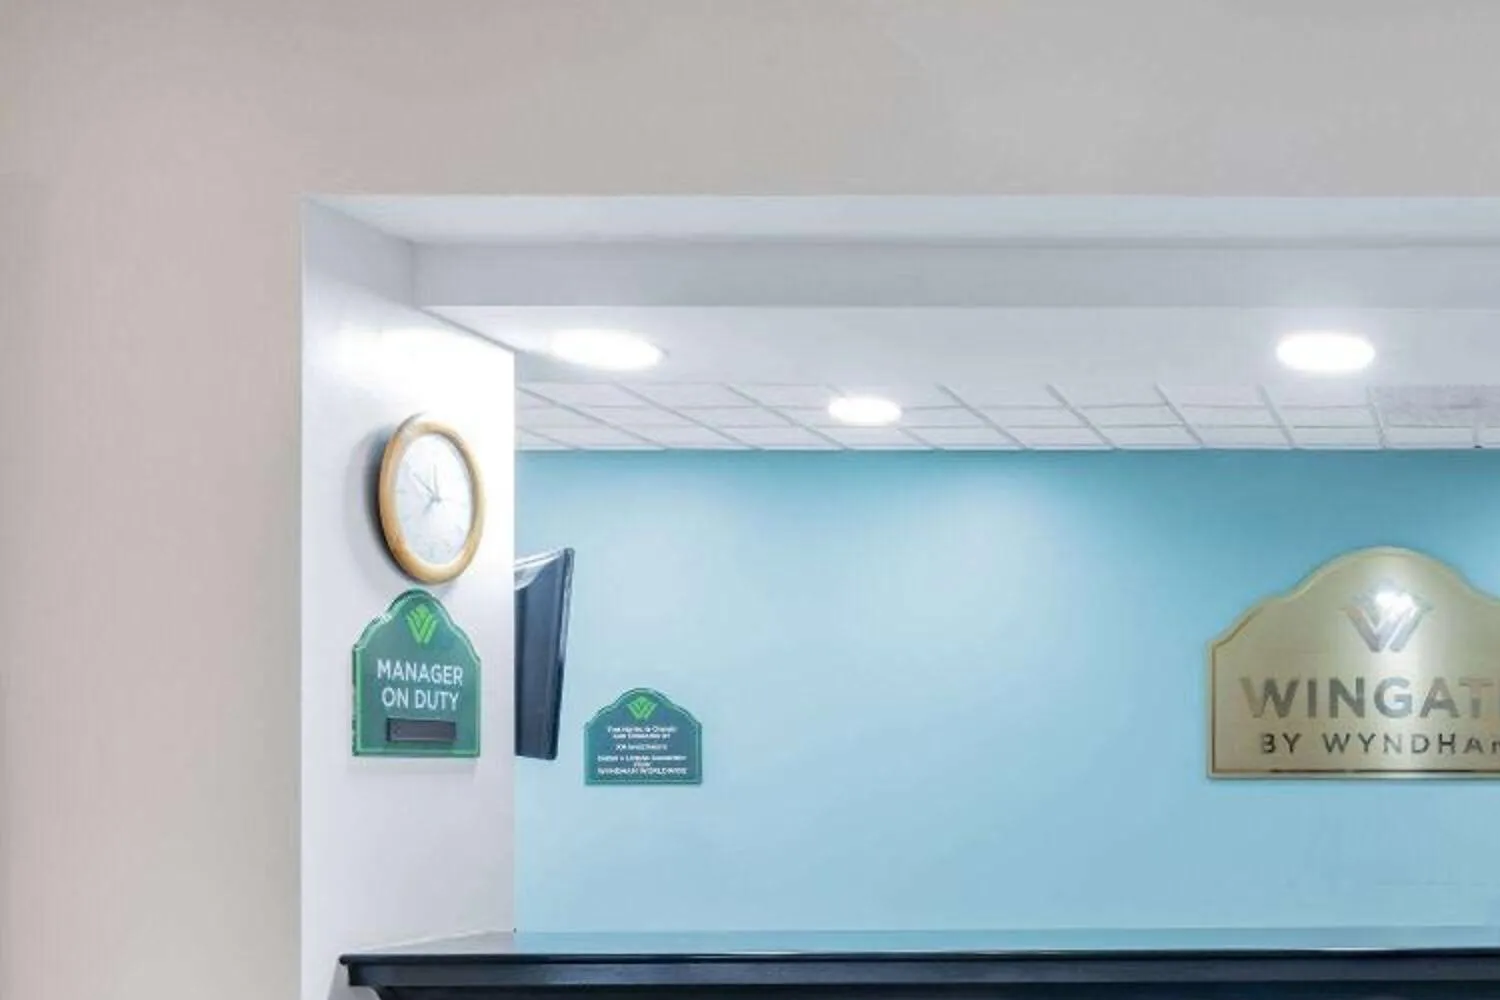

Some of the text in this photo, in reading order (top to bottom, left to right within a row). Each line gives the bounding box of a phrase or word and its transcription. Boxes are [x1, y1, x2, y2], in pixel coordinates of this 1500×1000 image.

[377, 658, 464, 686] MANAGER
[381, 687, 459, 711] ON DUTY
[1261, 732, 1303, 755] BY
